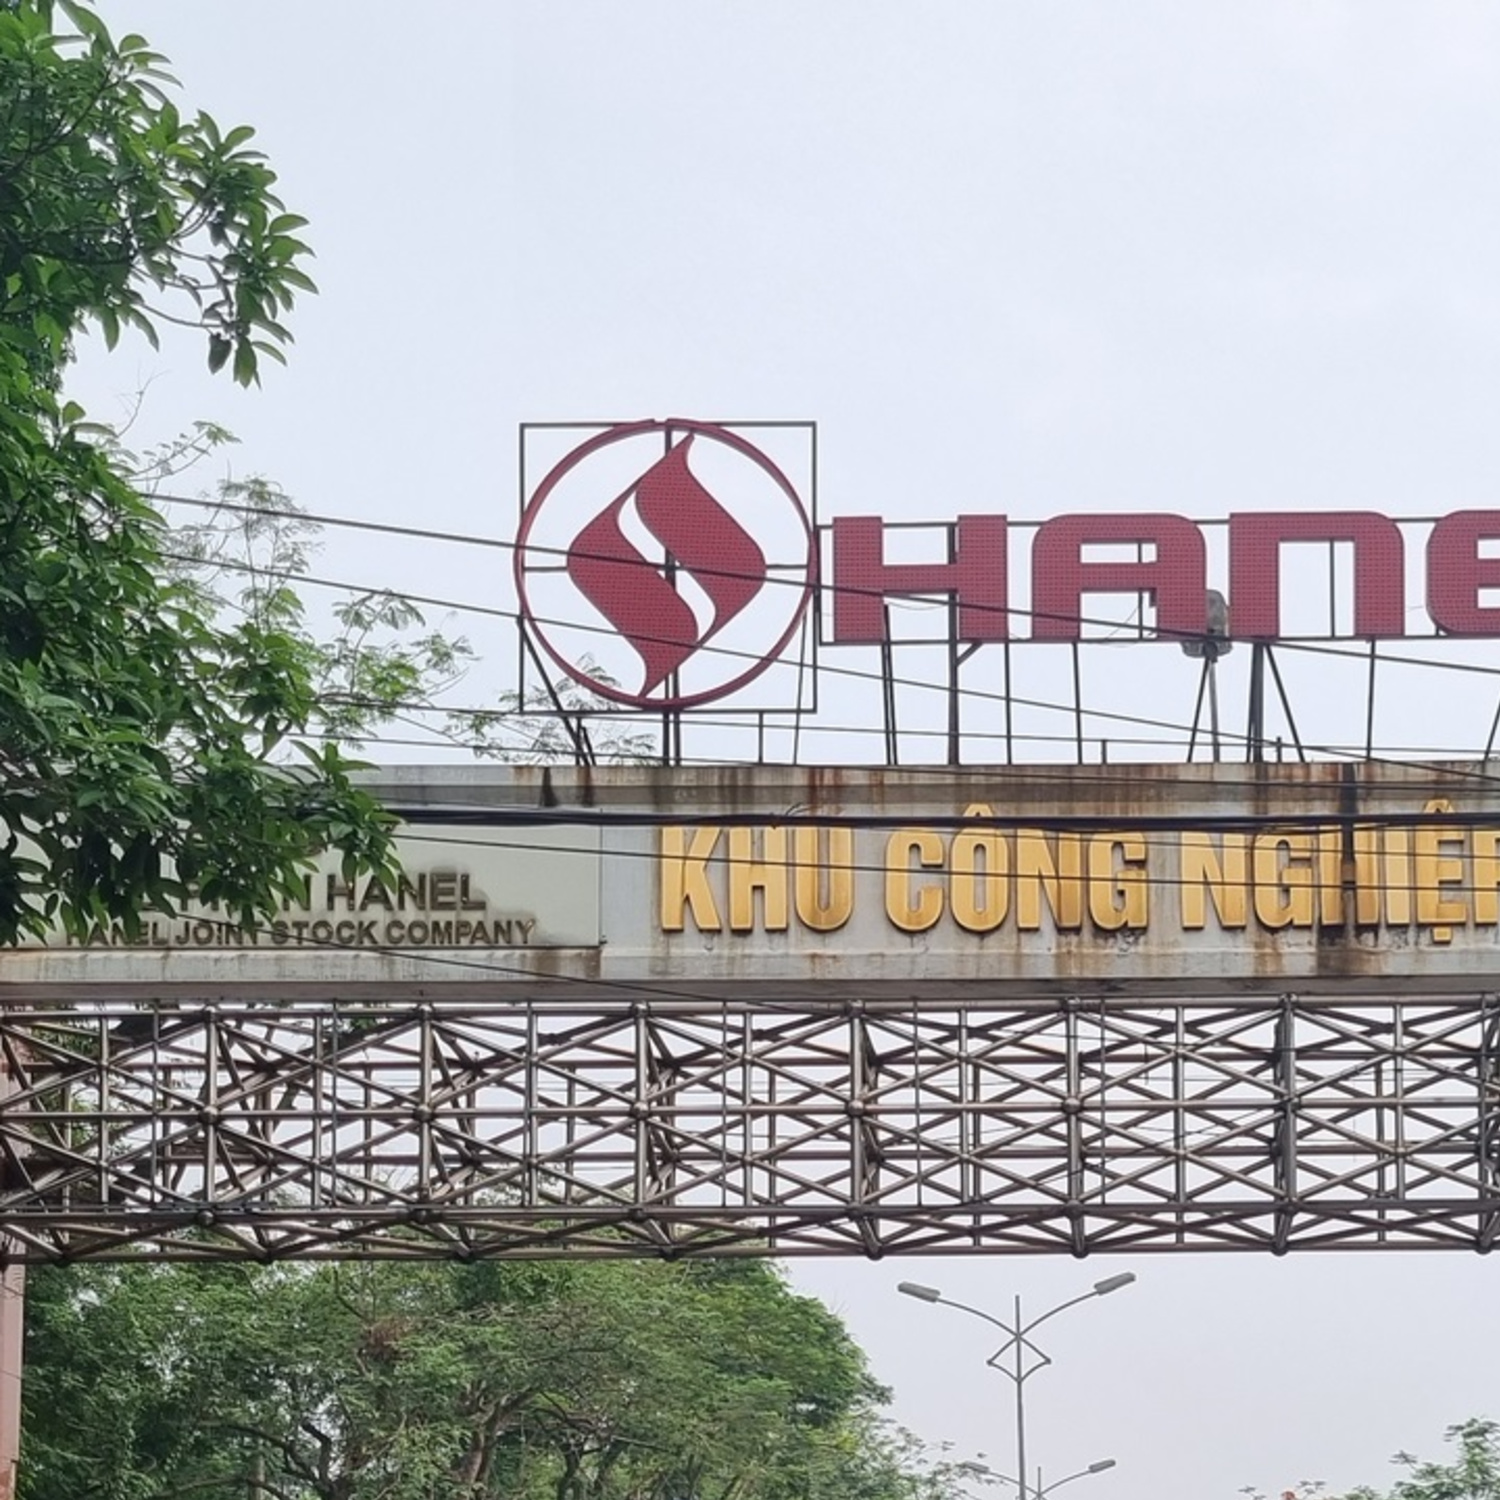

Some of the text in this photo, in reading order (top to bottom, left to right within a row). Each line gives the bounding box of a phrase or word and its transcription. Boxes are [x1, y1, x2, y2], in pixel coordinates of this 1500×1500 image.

[660, 822, 853, 931] KHU
[884, 803, 1149, 932] CÔNG
[327, 874, 486, 912] HANEL
[271, 920, 379, 946] STOCK
[385, 919, 536, 946] COMPANY
